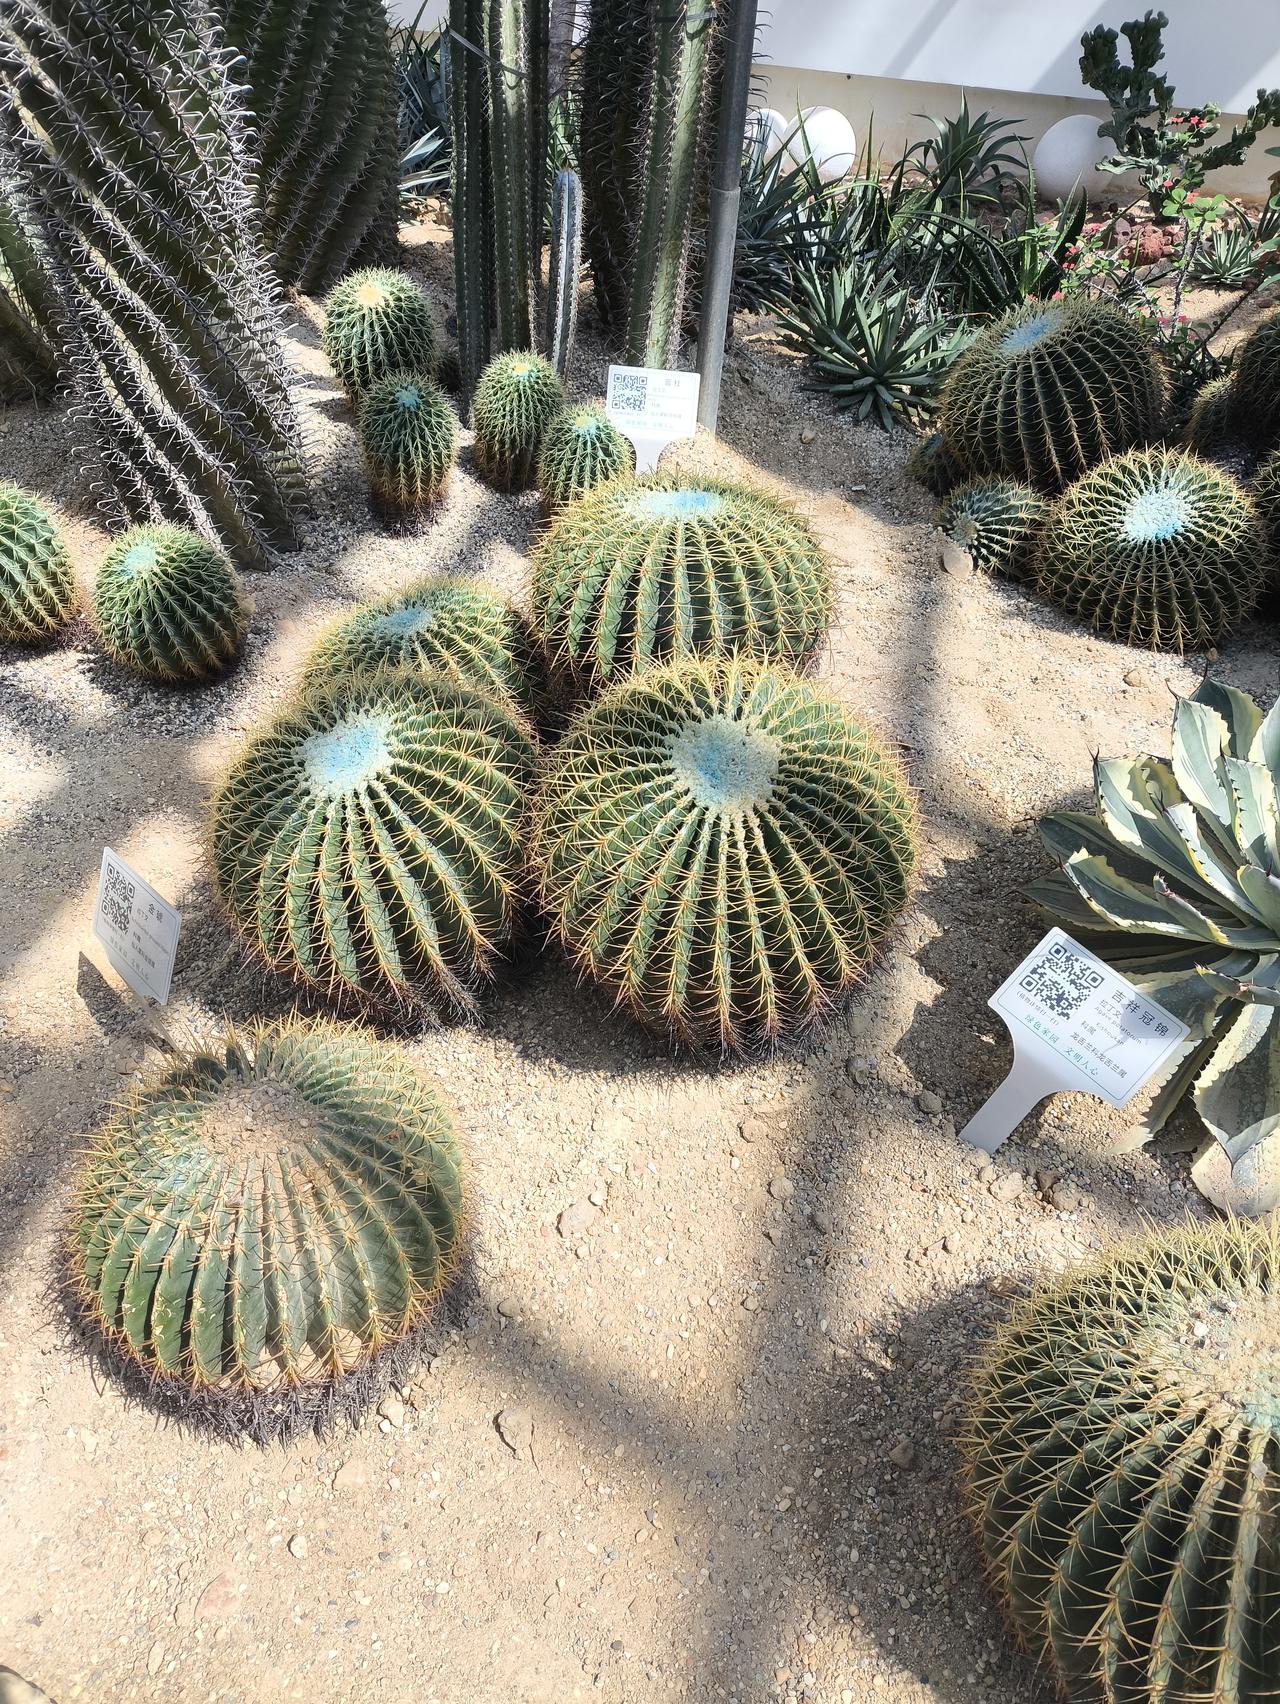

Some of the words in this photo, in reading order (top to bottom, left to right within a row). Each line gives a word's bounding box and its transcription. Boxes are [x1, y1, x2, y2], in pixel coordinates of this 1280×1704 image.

[1098, 998, 1123, 1019] 拉丁文
[1108, 987, 1171, 1038] 吉祥冠锦
[1068, 1030, 1128, 1079] 龙舌兰科龙舌兰属
